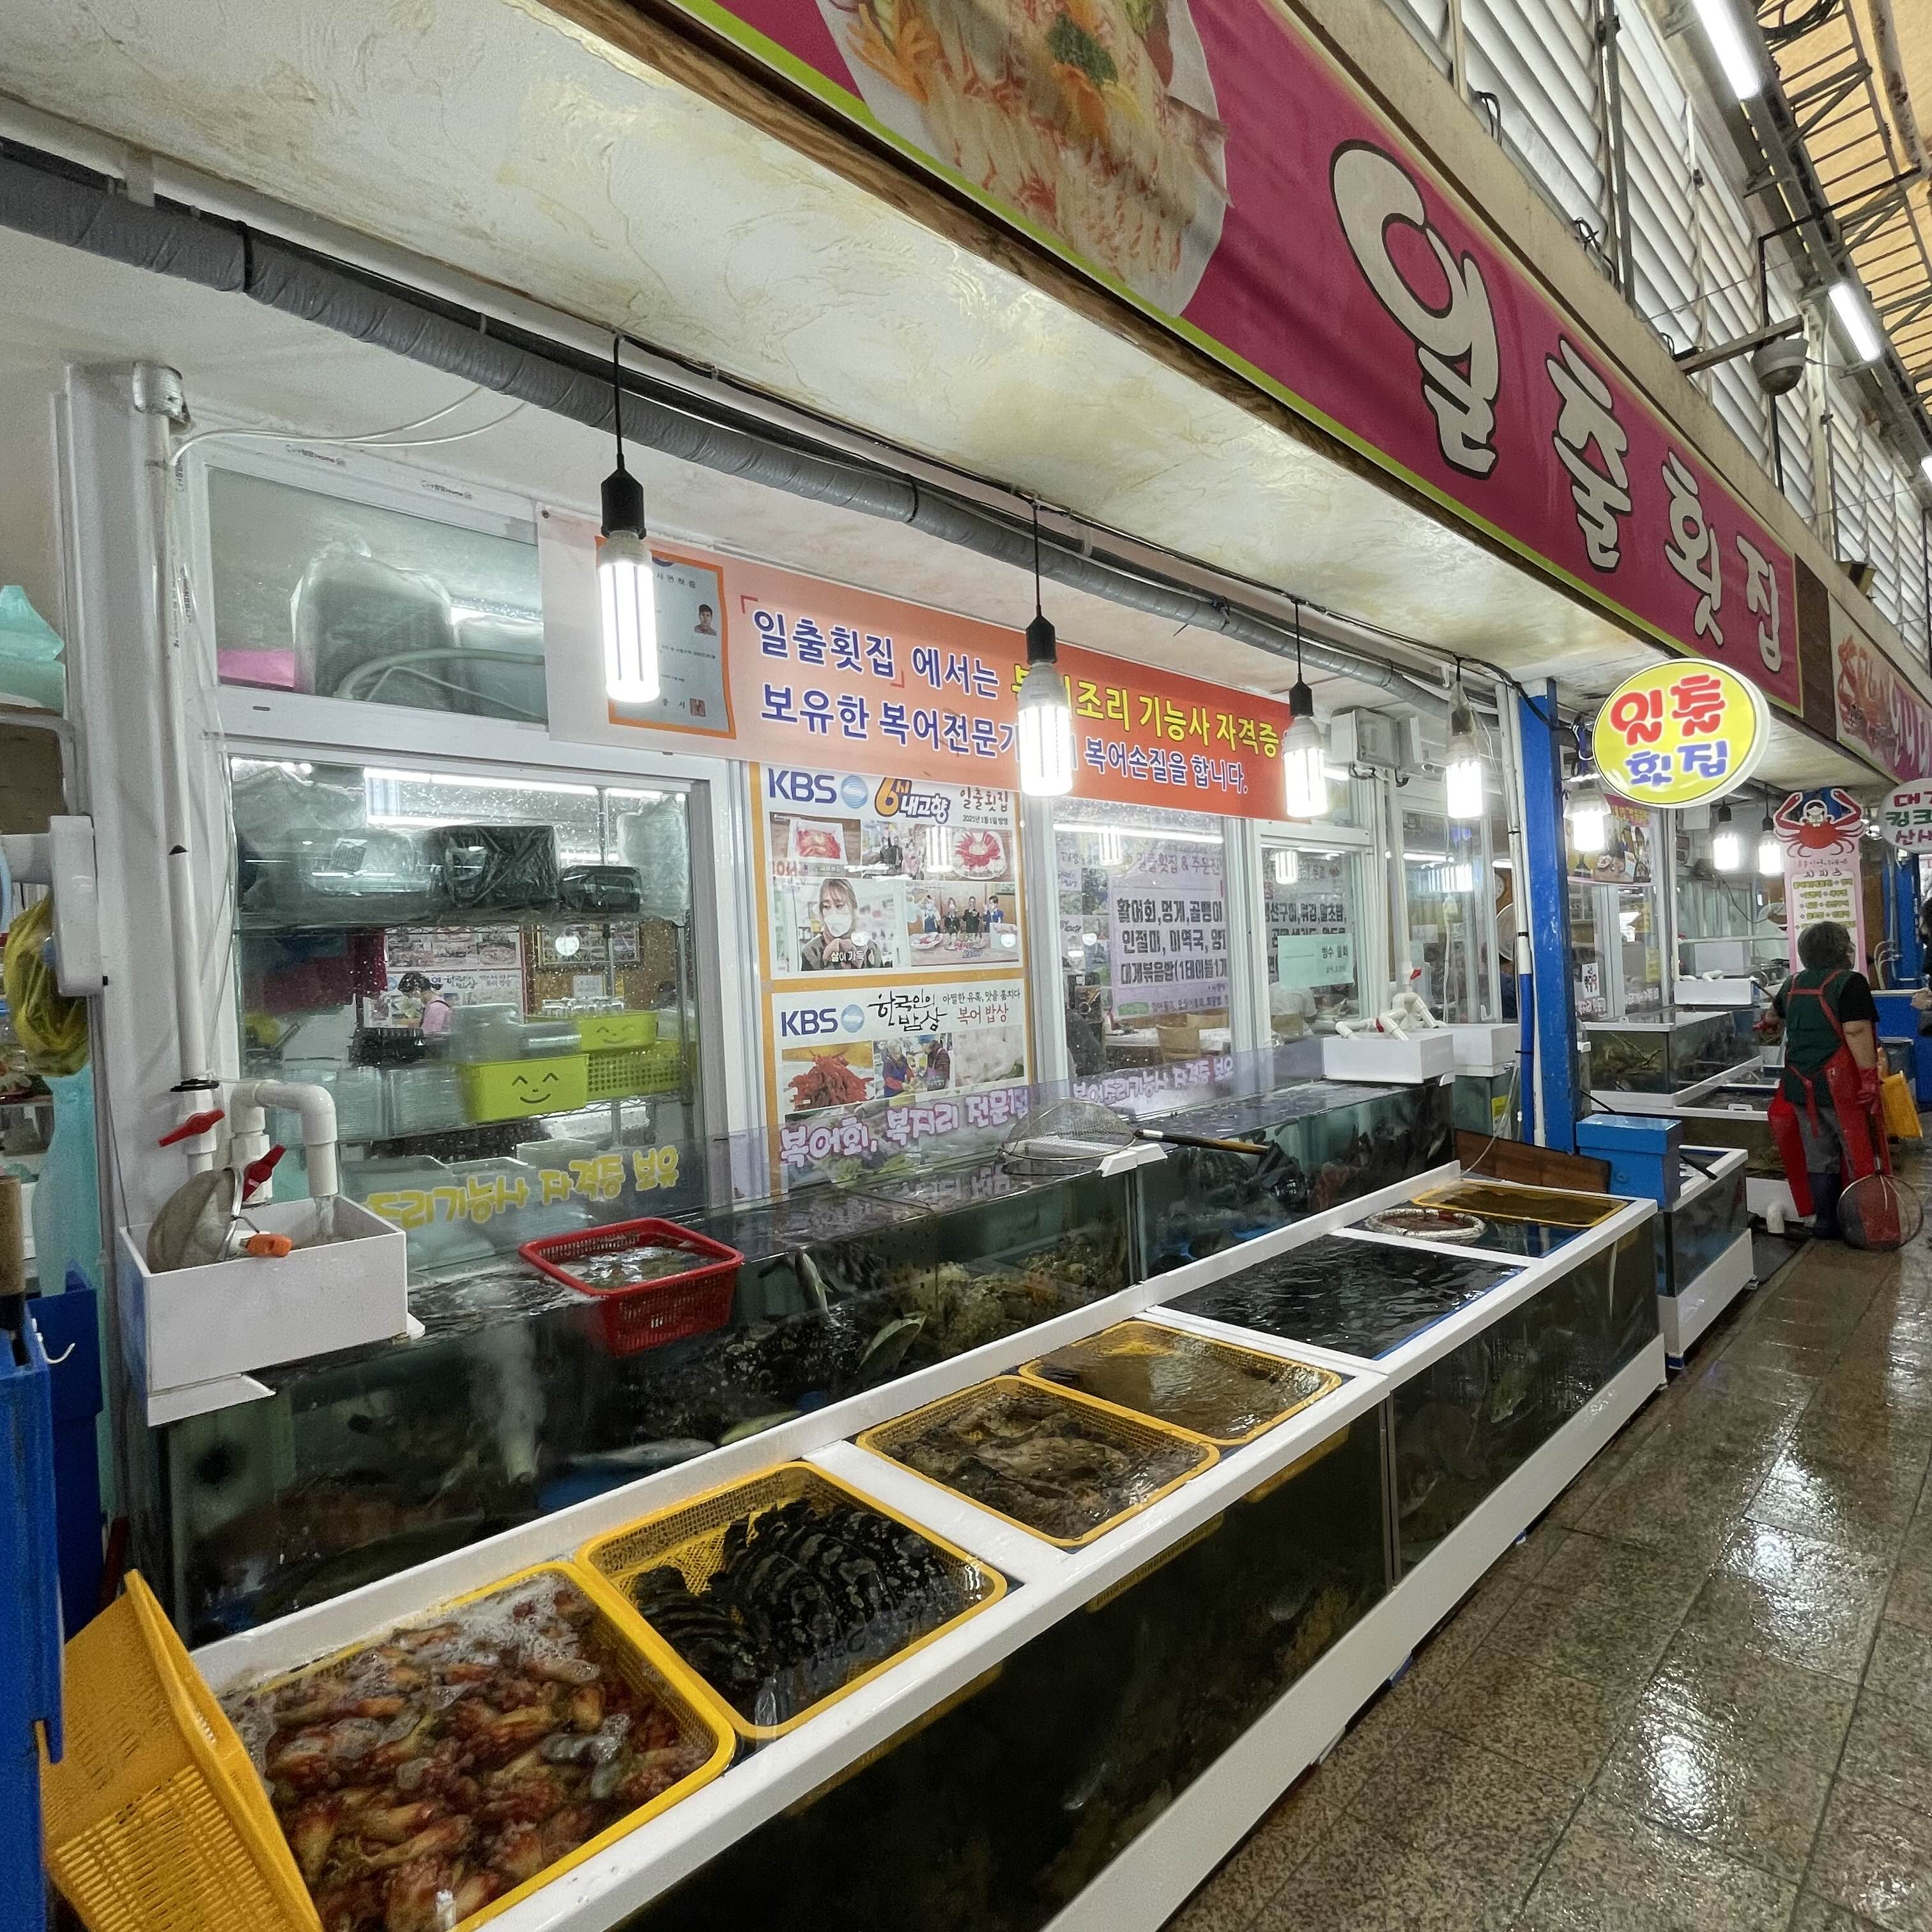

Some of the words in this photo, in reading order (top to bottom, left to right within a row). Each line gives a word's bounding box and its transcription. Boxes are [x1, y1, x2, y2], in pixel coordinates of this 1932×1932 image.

[1330, 138, 1783, 674] 일출횟집
[912, 644, 999, 700] 에서는
[1138, 694, 1211, 746] 기능사
[1215, 712, 1289, 760] 자격증
[1609, 673, 1726, 747] 일출
[760, 681, 870, 741] 보유한
[1084, 736, 1188, 785] 복어손질을
[1191, 755, 1249, 795] 합니다.
[768, 767, 837, 804] KBS
[1625, 740, 1728, 788] 횟집
[874, 776, 913, 818] 6시
[899, 792, 951, 824] 내고향
[960, 786, 1009, 813] 일출횟집
[866, 988, 936, 1026] 한국인의
[898, 1004, 948, 1032] 밥상
[957, 1005, 982, 1025] 복어
[985, 1002, 1009, 1023] 밥상
[967, 992, 984, 1003] 유혹,
[985, 990, 999, 1002] 맛을
[781, 1008, 838, 1037] KBS
[779, 1114, 878, 1168] 복어회,
[885, 1103, 959, 1147] 복지리
[538, 1153, 626, 1206] 자격증
[632, 1144, 680, 1192] 보유
